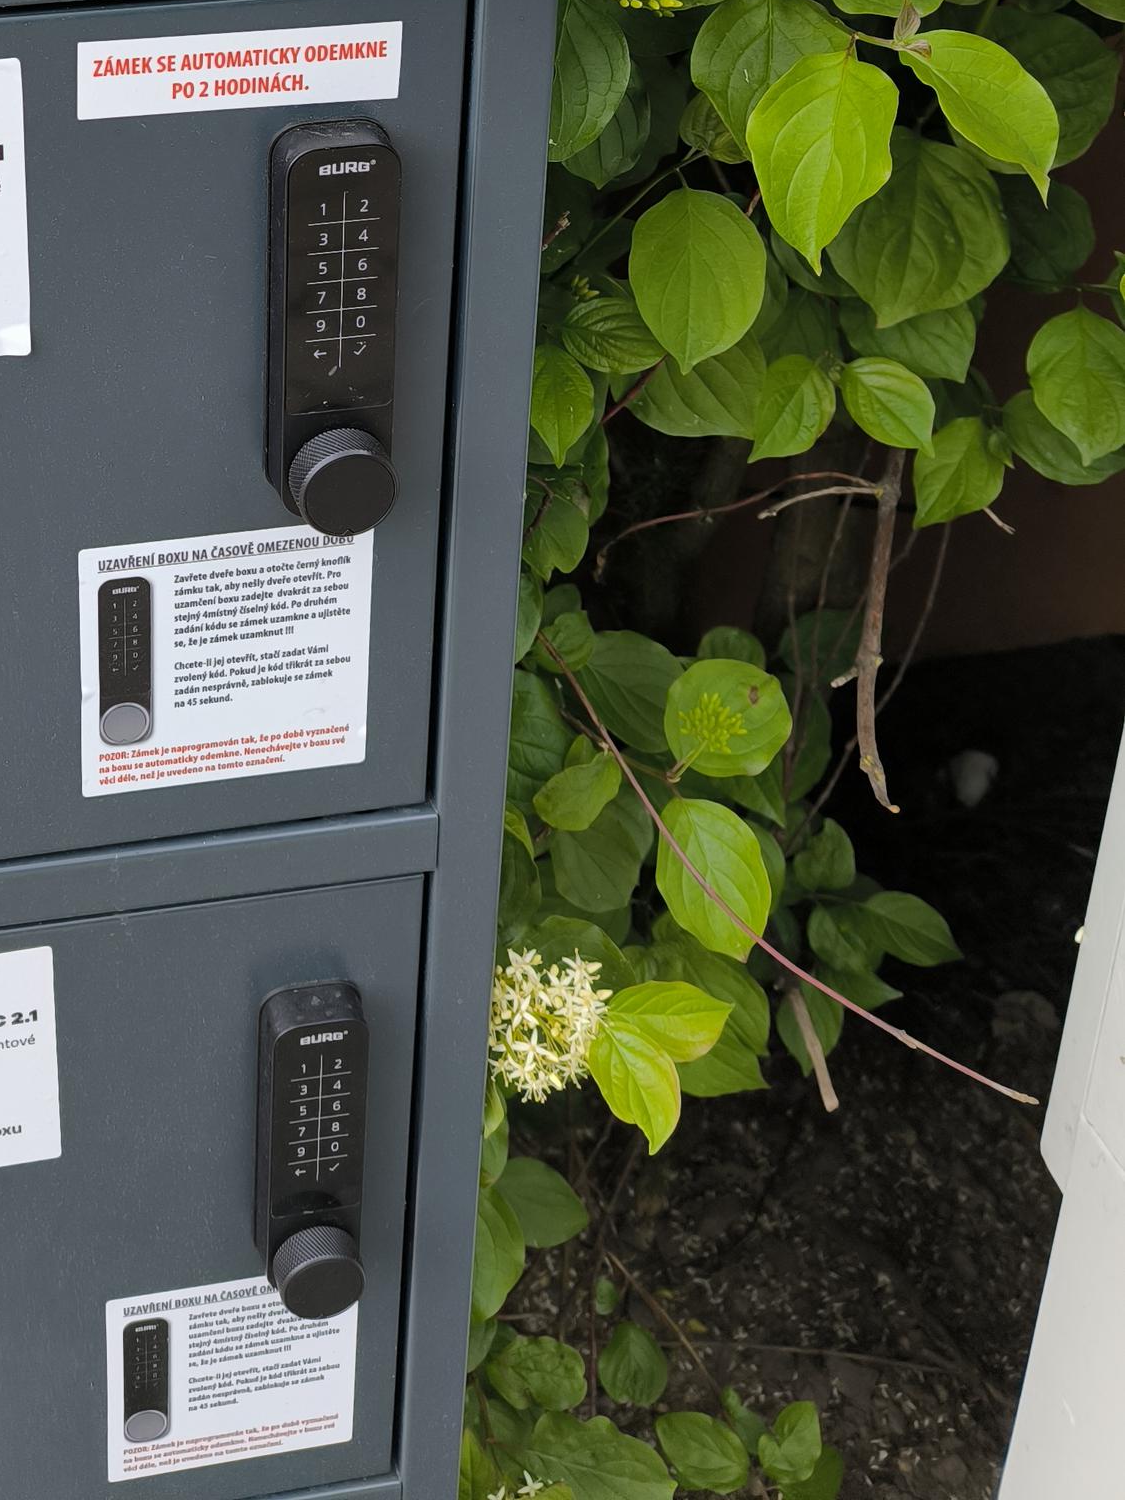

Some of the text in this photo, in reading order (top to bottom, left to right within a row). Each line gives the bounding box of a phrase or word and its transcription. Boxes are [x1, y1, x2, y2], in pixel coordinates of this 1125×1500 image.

[93, 40, 387, 77] ZÁMEK SE AUTOMATICKY ODEMKNE
[172, 72, 309, 99] PO 2 HODINÁCH.
[98, 552, 155, 571] UZAVŘENÍ
[158, 551, 188, 565] BOXU
[192, 549, 208, 562] NA
[210, 541, 254, 558] ČASOVĚ
[257, 535, 320, 553] OMEZENOU
[11, 1009, 37, 1025] 2.1
